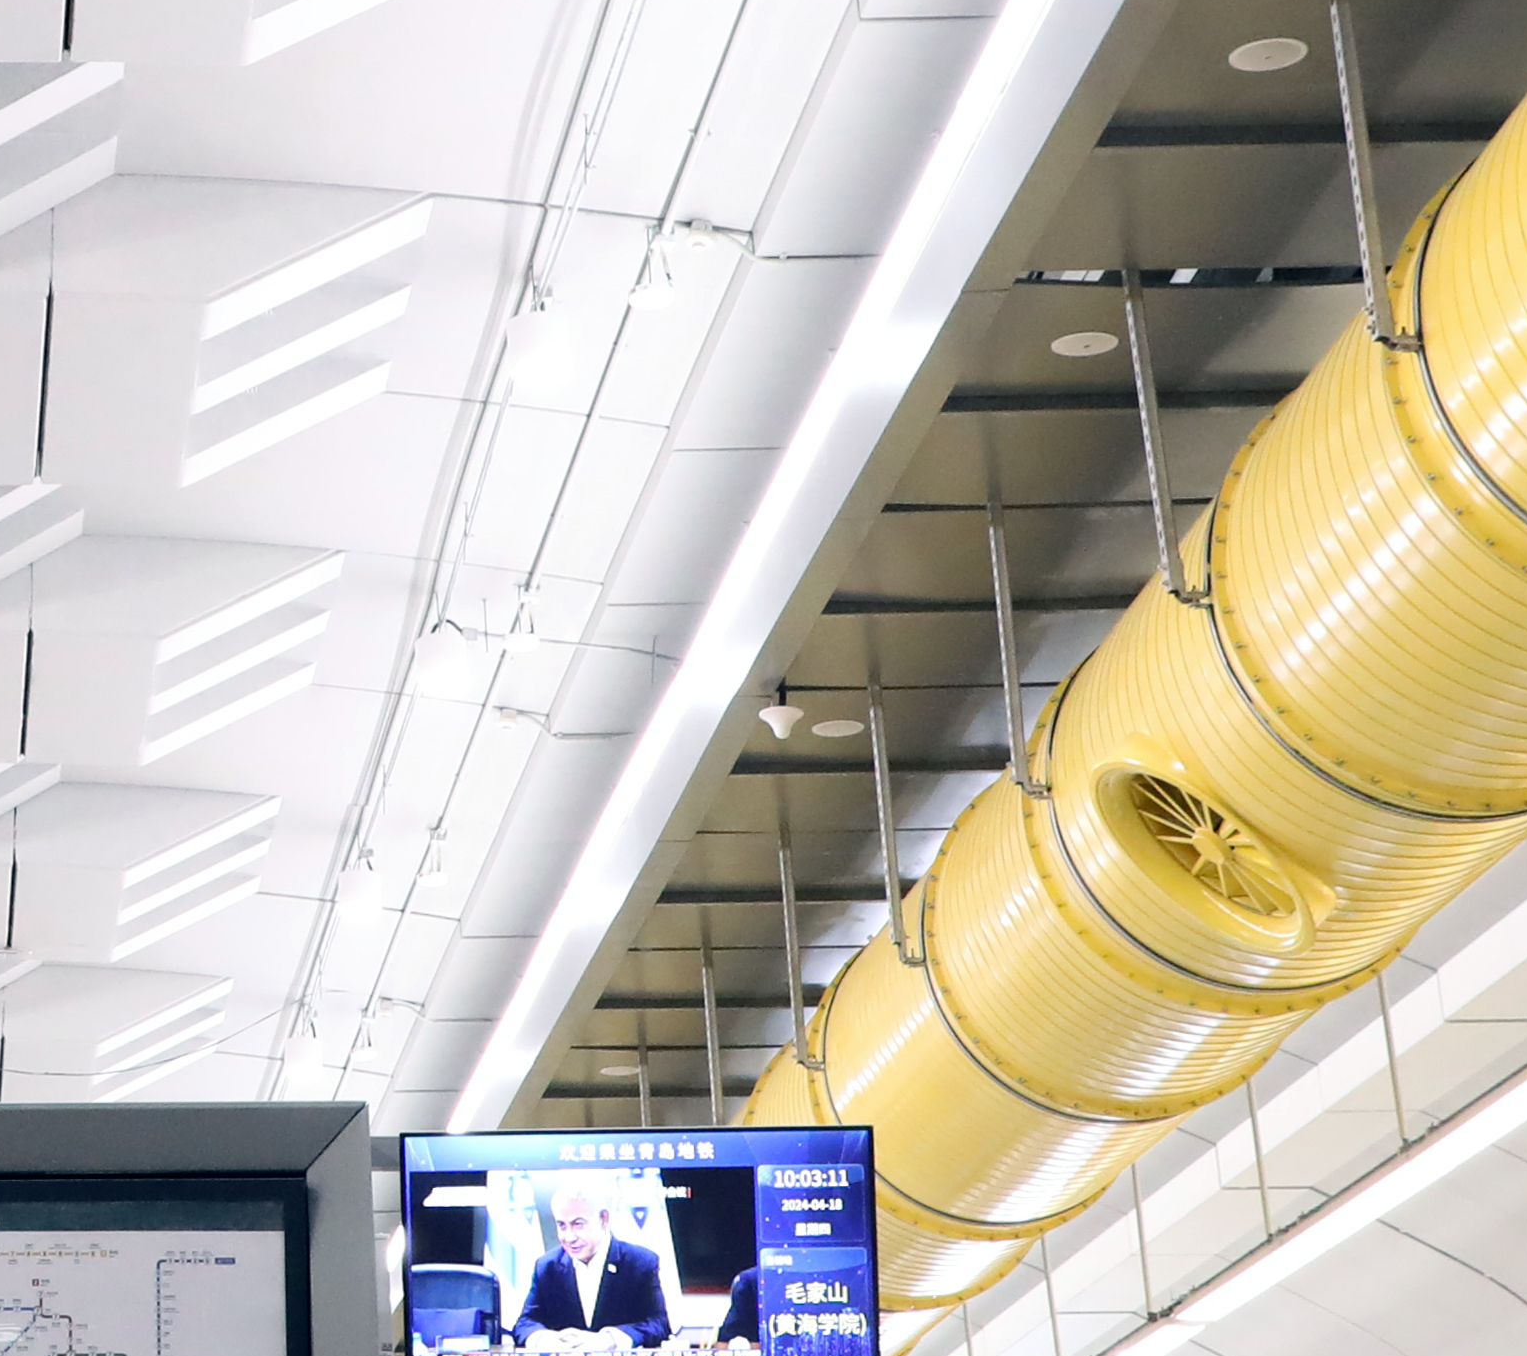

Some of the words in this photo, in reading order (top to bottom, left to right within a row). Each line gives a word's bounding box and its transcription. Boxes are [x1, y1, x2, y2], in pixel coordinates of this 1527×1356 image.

[559, 1142, 715, 1161] 欢迎乘坐青岛地铁
[774, 1169, 849, 1188] 10:03:11
[781, 1198, 843, 1211] 2024-04-18
[785, 1281, 848, 1304] 毛家山
[768, 1313, 867, 1337] (黄海学院)
